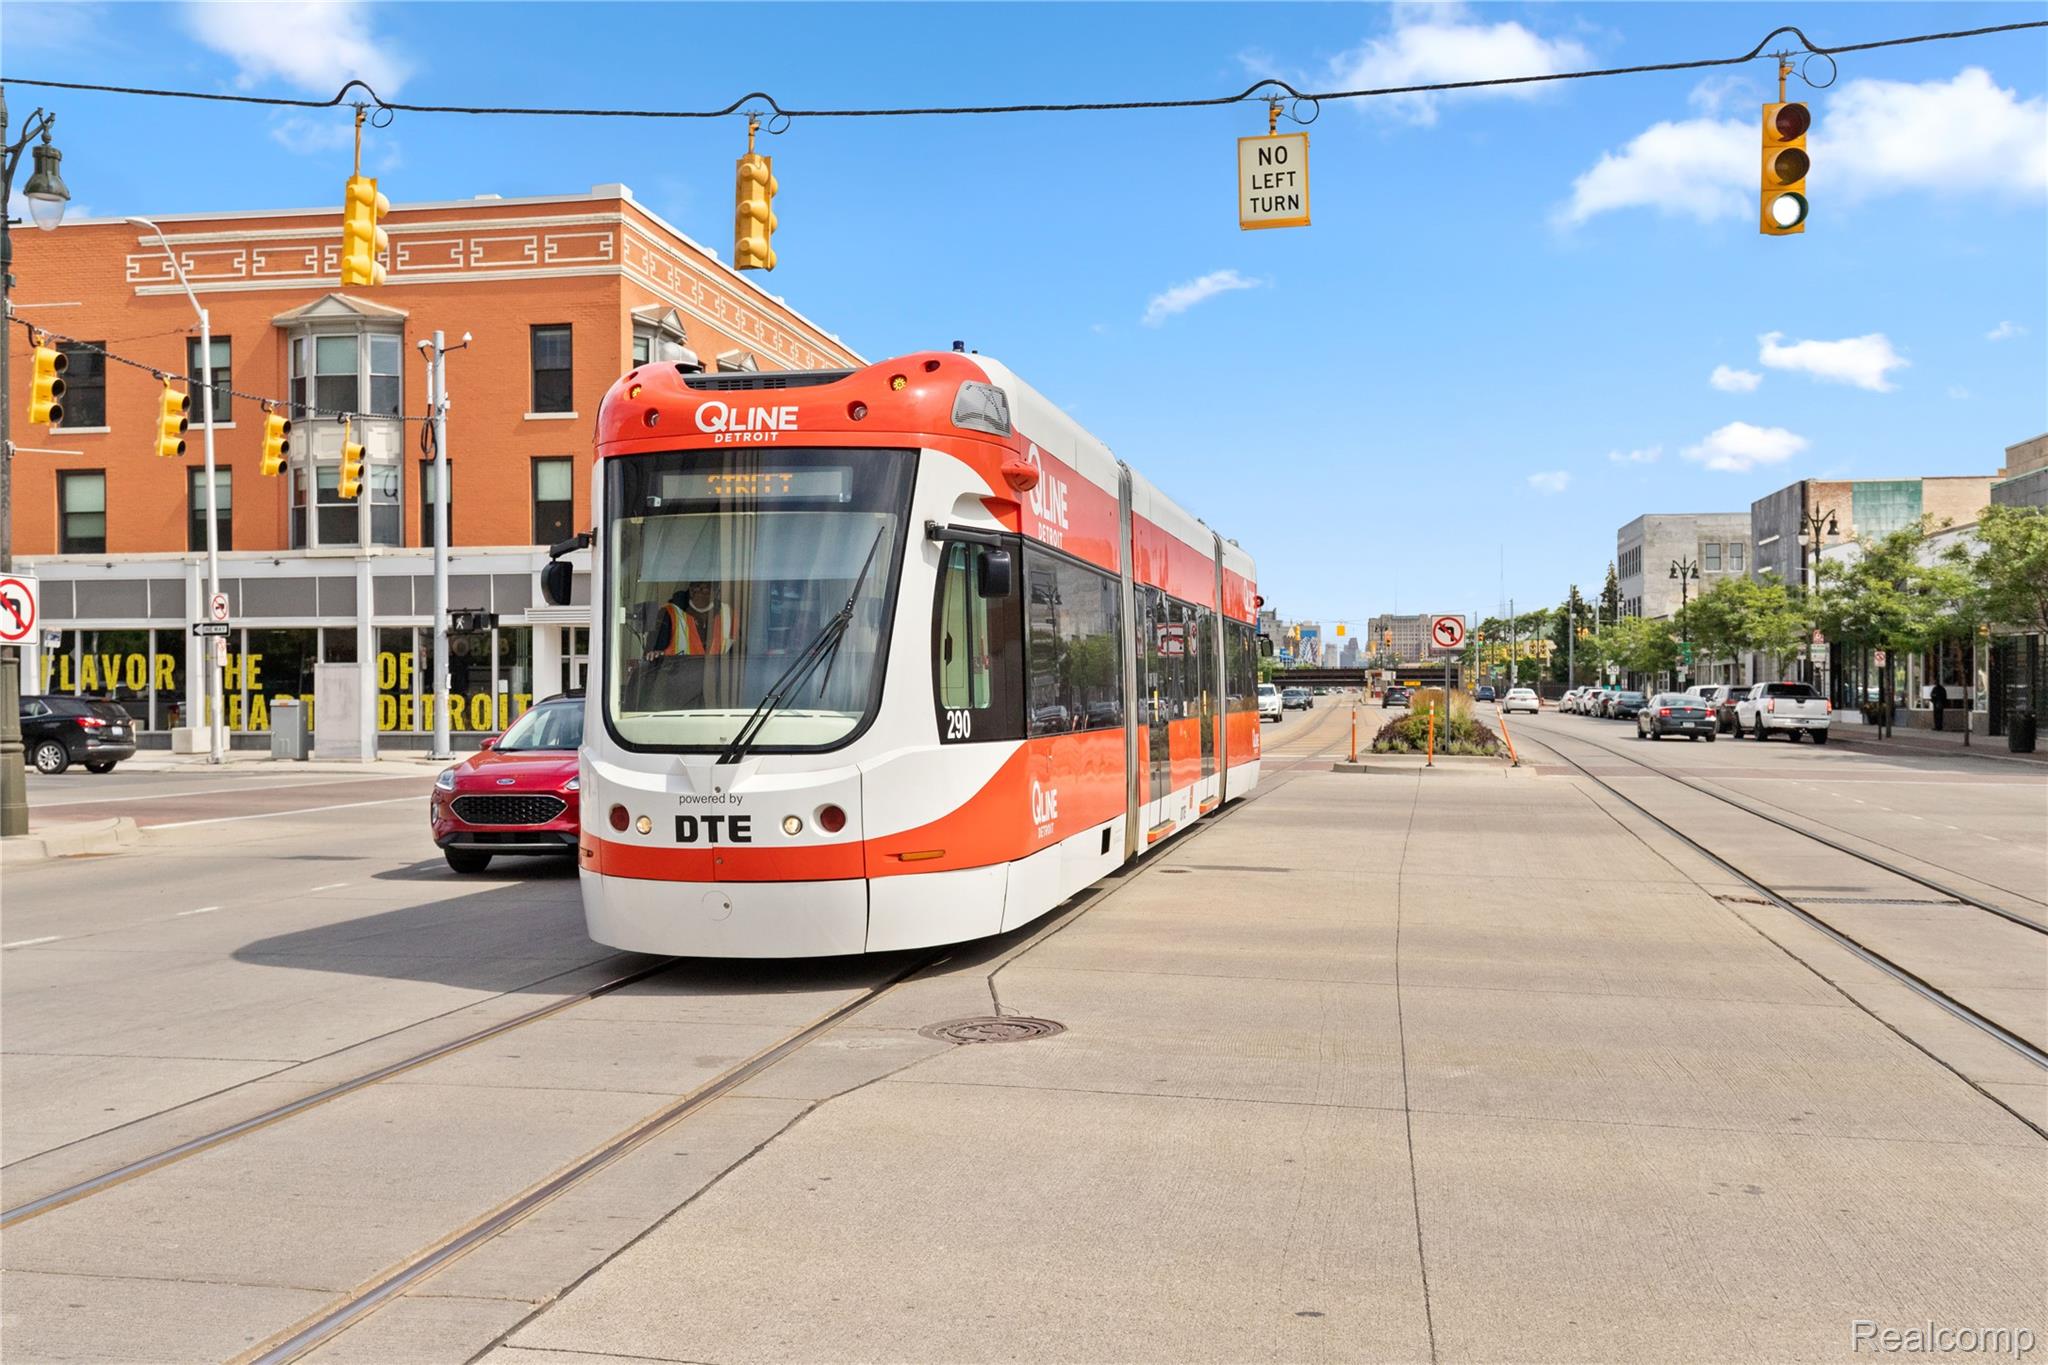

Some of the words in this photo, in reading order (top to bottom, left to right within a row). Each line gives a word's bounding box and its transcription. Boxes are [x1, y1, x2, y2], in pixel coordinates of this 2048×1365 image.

[1258, 145, 1288, 166] NO
[1252, 171, 1296, 190] LEFT
[1250, 194, 1299, 213] TURN
[695, 401, 799, 433] QLINE
[714, 432, 779, 443] DETROIT
[1028, 443, 1068, 529] QLINE
[1038, 522, 1063, 550] DETROIT
[40, 653, 176, 691] FLAVOR
[376, 652, 413, 690] OF
[205, 694, 315, 731] EAT
[378, 693, 533, 732] DETROIT
[946, 710, 971, 739] 290
[679, 793, 726, 806] powered
[729, 793, 743, 806] by
[1032, 780, 1058, 825] QLINE
[675, 815, 752, 843] DTE
